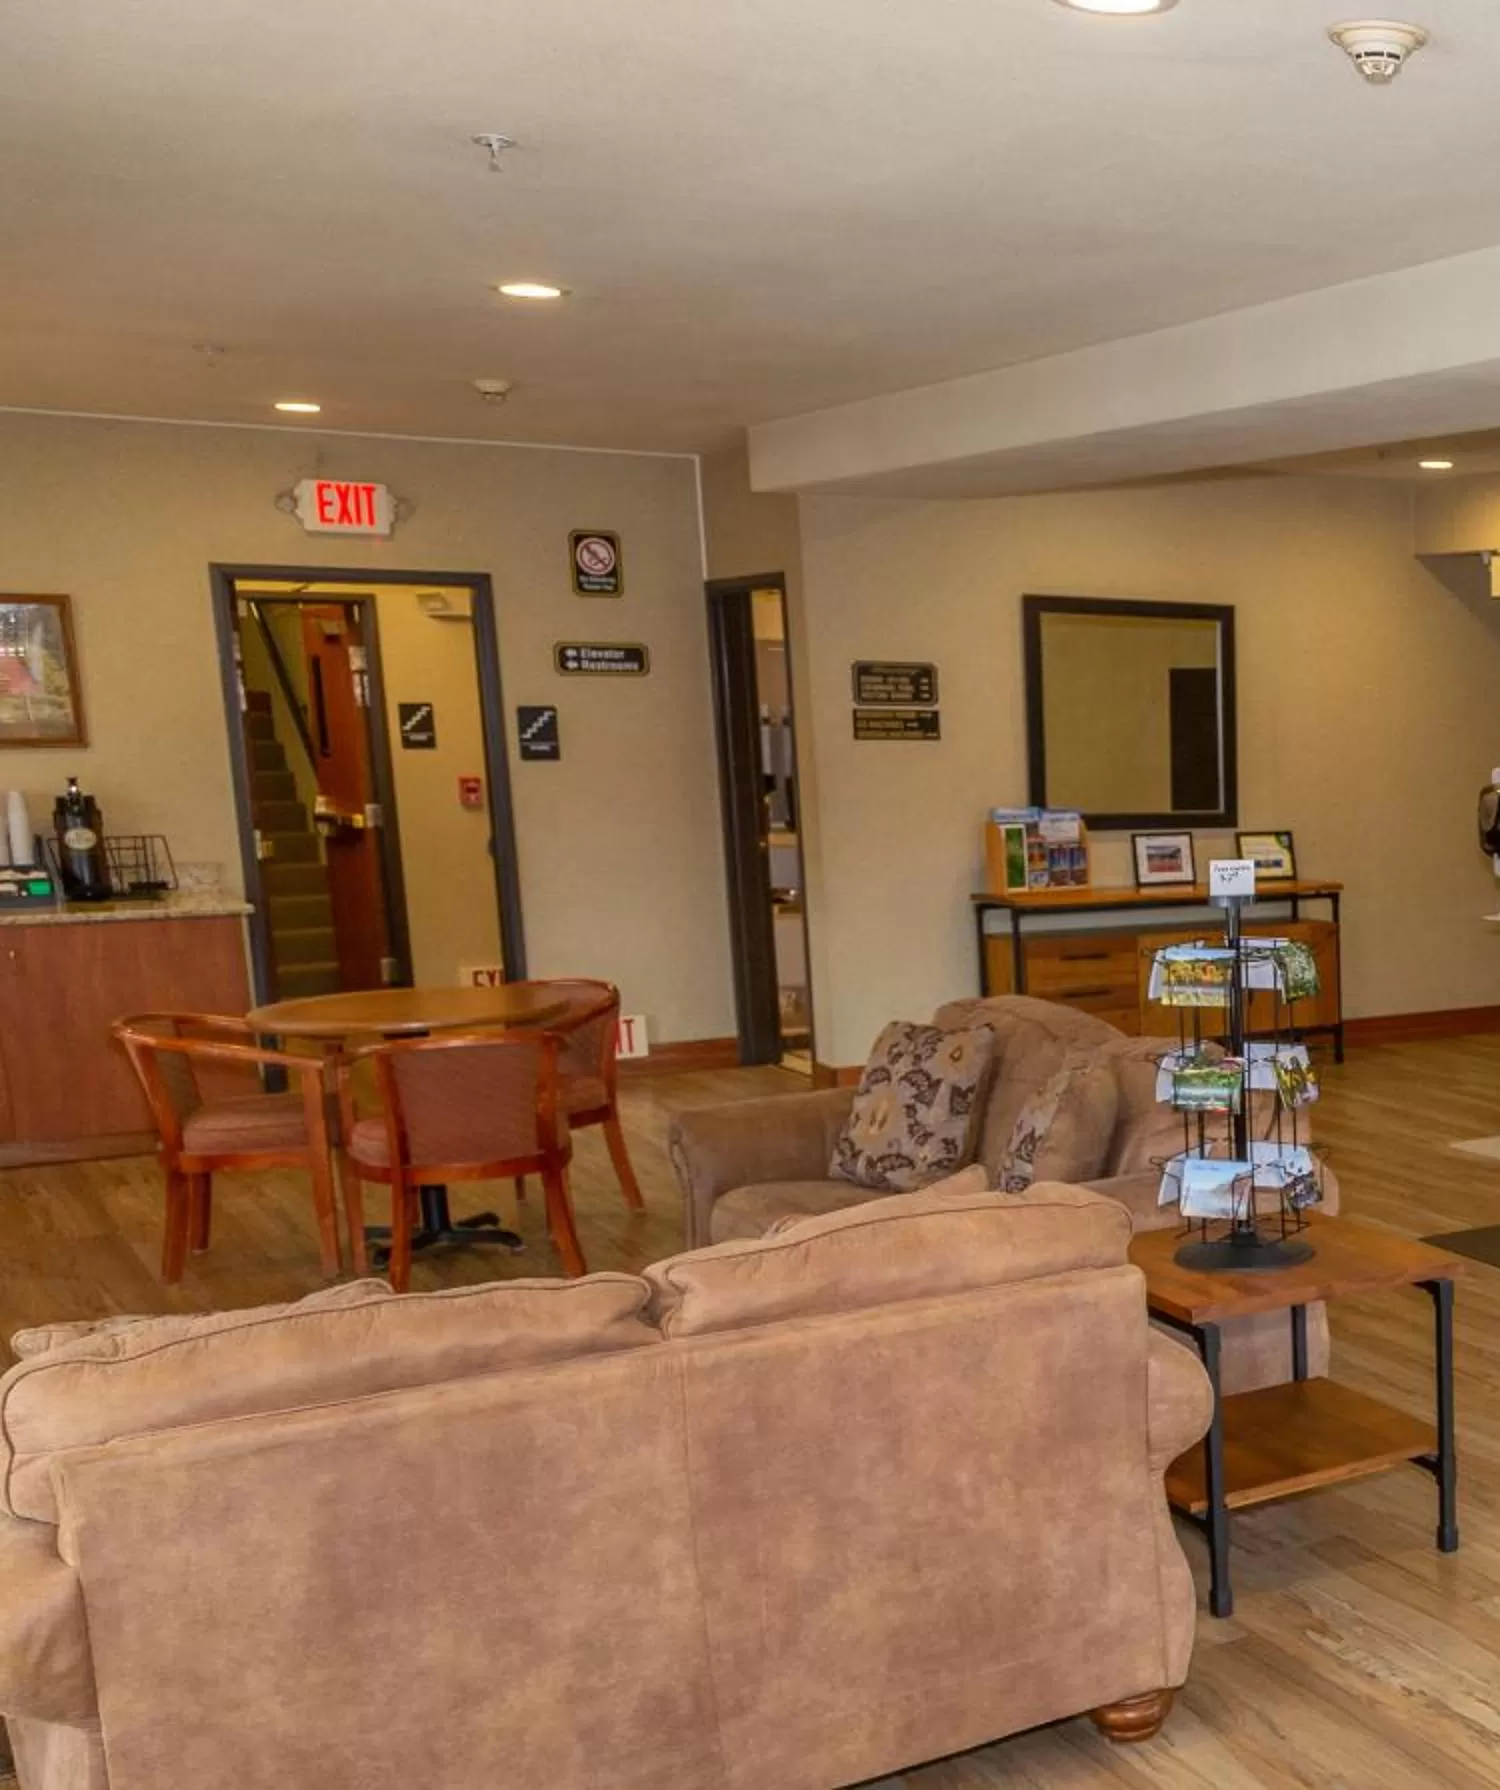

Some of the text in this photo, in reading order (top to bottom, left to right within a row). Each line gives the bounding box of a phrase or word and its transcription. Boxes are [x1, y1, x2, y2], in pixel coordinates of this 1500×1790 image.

[317, 482, 376, 527] EXIT
[580, 648, 625, 659] Elevator
[580, 660, 639, 671] Restrooms
